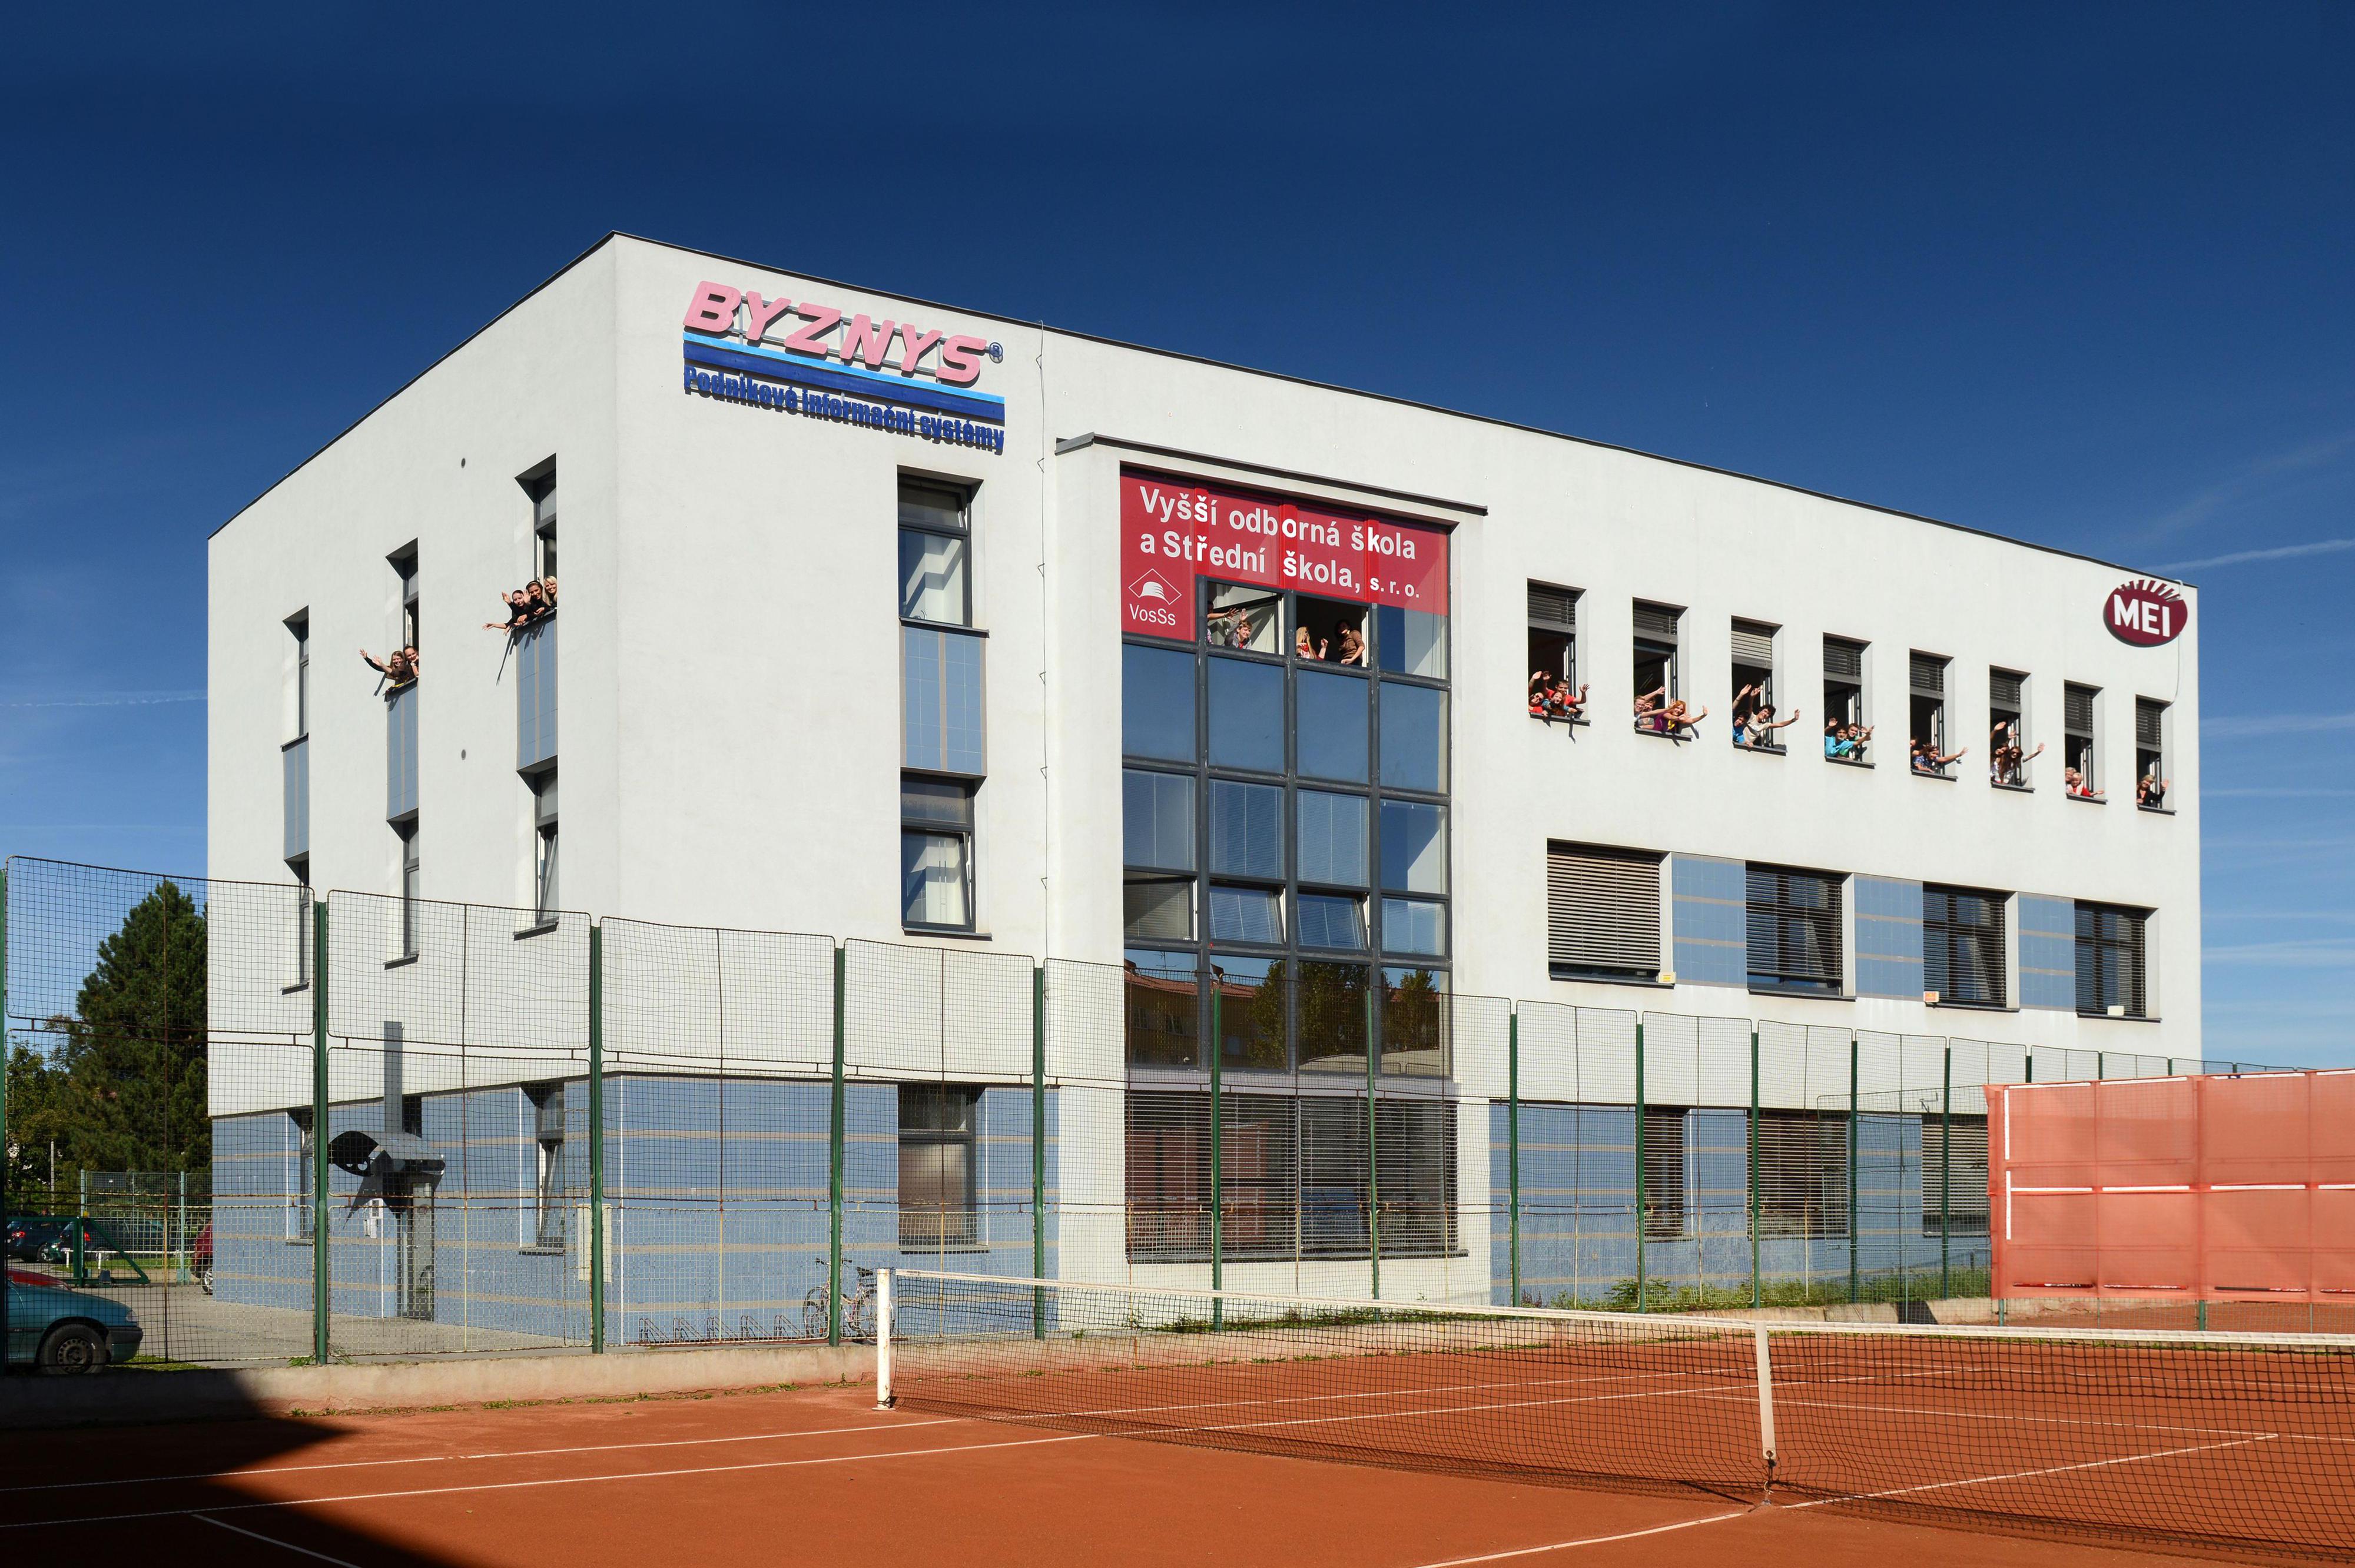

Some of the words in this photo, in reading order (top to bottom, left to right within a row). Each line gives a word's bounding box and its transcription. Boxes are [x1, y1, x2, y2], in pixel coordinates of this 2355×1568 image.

[684, 365, 798, 409] Podnikové
[802, 388, 916, 431] informační
[920, 415, 1005, 453] systémy
[1140, 486, 1217, 525] Vyšší
[1229, 507, 1340, 547] odborná
[1351, 525, 1416, 560] škola
[1140, 533, 1156, 554] a
[1163, 530, 1265, 573] Střední
[1283, 550, 1360, 593] škola,
[1129, 603, 1176, 626] VosSs
[2114, 594, 2170, 637] MEI
